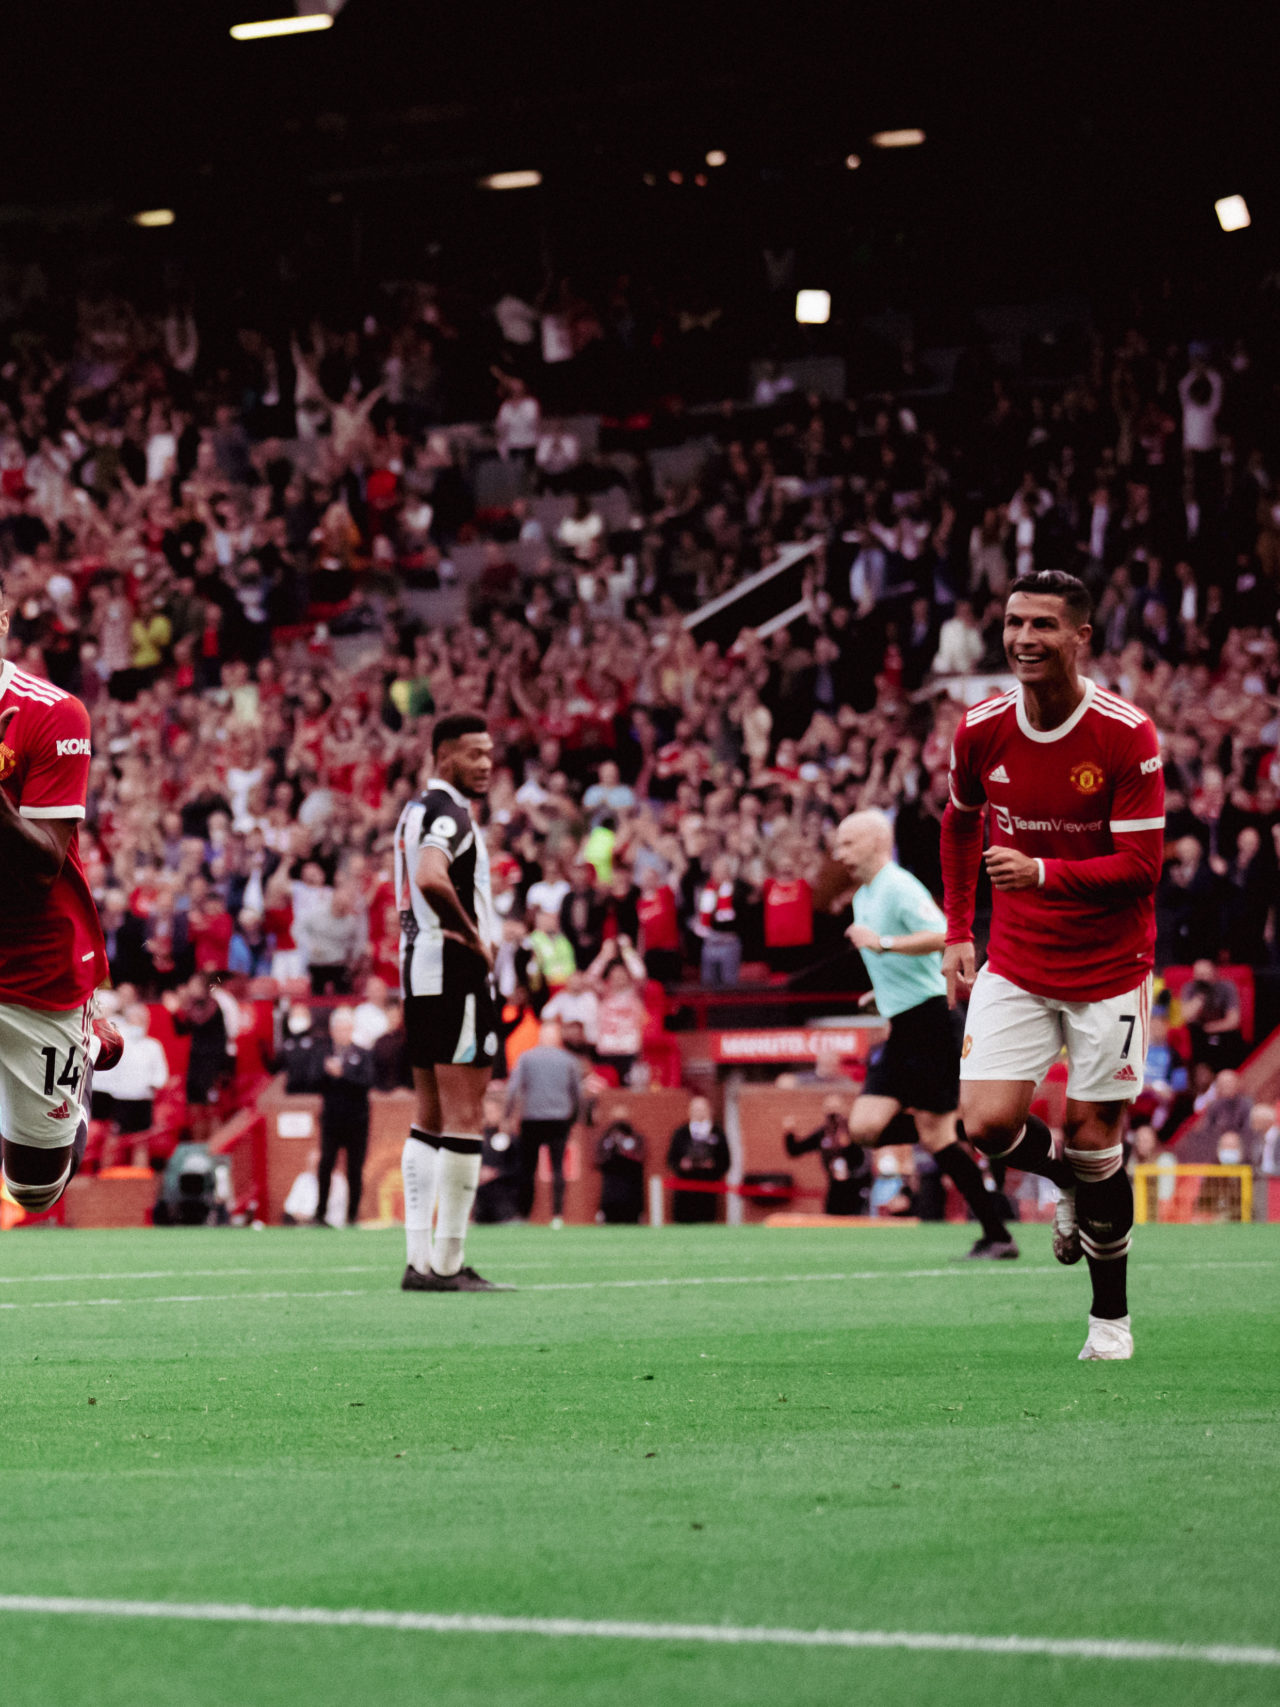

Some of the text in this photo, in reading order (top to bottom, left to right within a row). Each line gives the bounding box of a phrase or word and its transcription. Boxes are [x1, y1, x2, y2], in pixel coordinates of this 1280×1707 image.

[1011, 815, 1103, 832] TeamViewer
[1119, 1015, 1137, 1059] 7
[41, 1046, 81, 1096] 14
